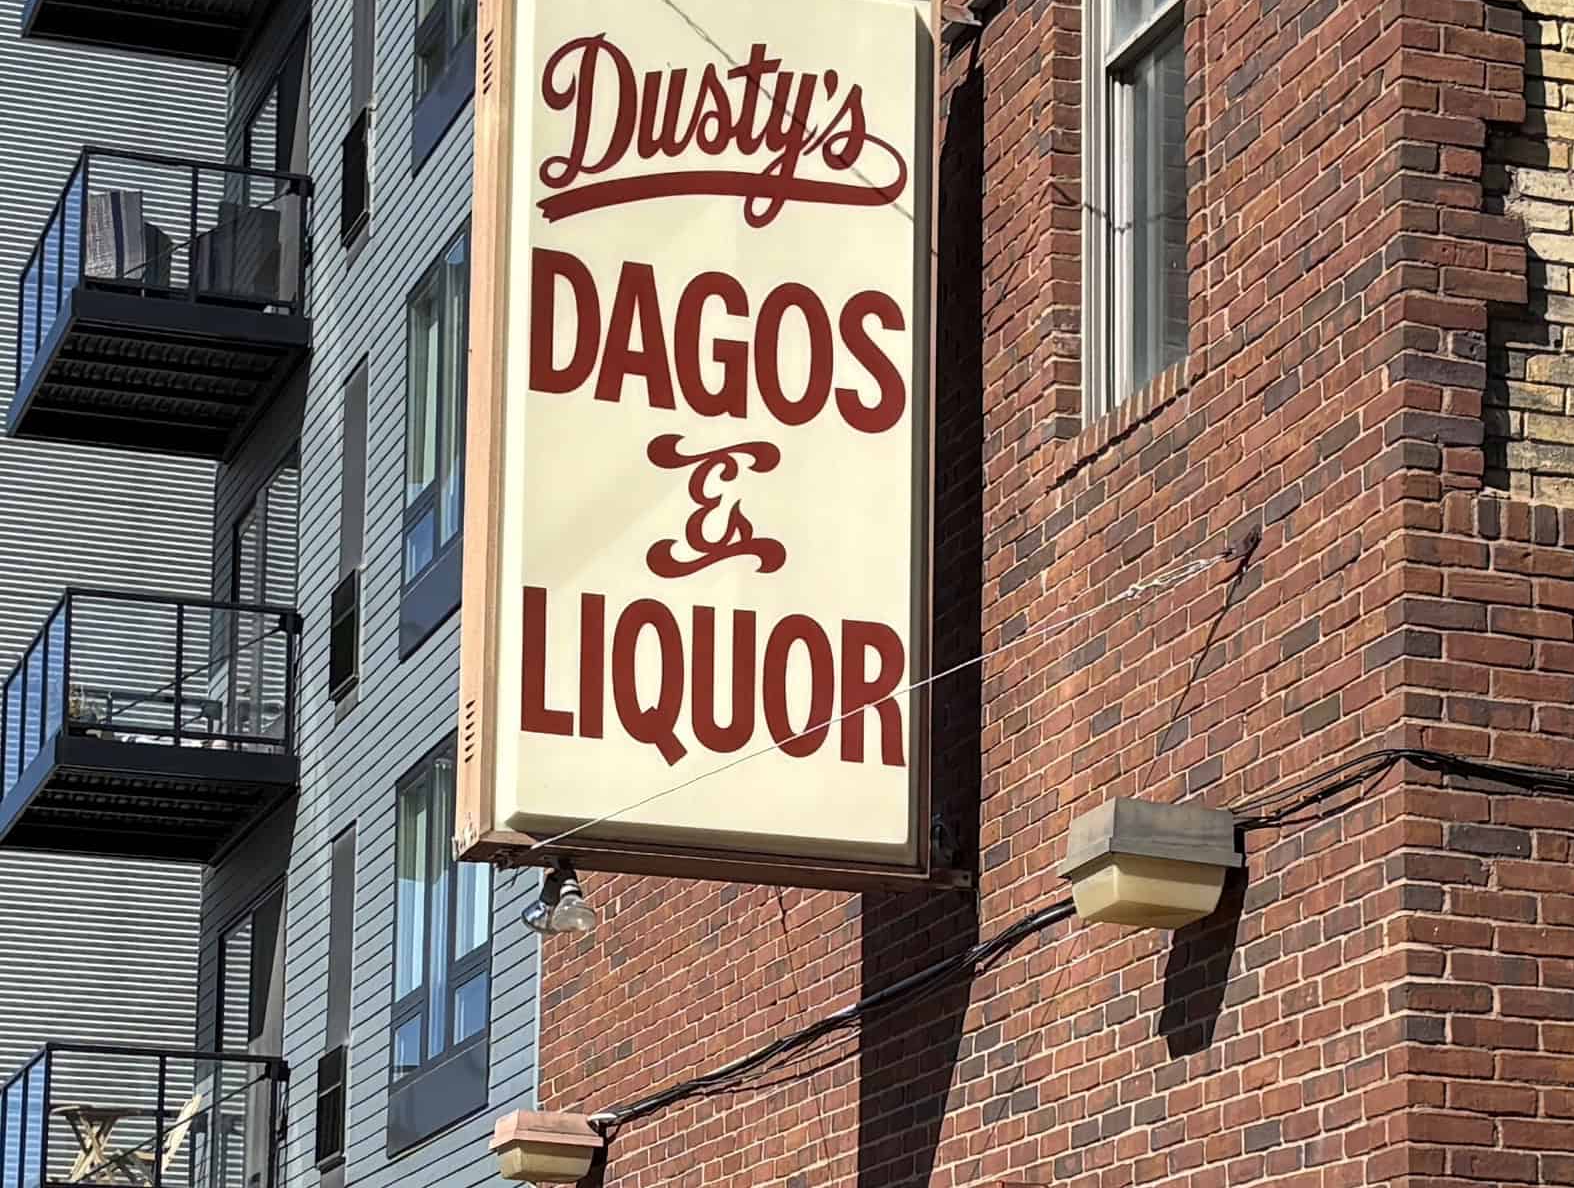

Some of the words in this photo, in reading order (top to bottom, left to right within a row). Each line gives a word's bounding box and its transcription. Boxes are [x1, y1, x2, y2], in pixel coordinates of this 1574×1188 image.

[539, 31, 908, 229] Dusty's
[529, 247, 907, 434] DAGOS
[646, 433, 786, 579] &
[520, 586, 907, 767] LIQUOR
